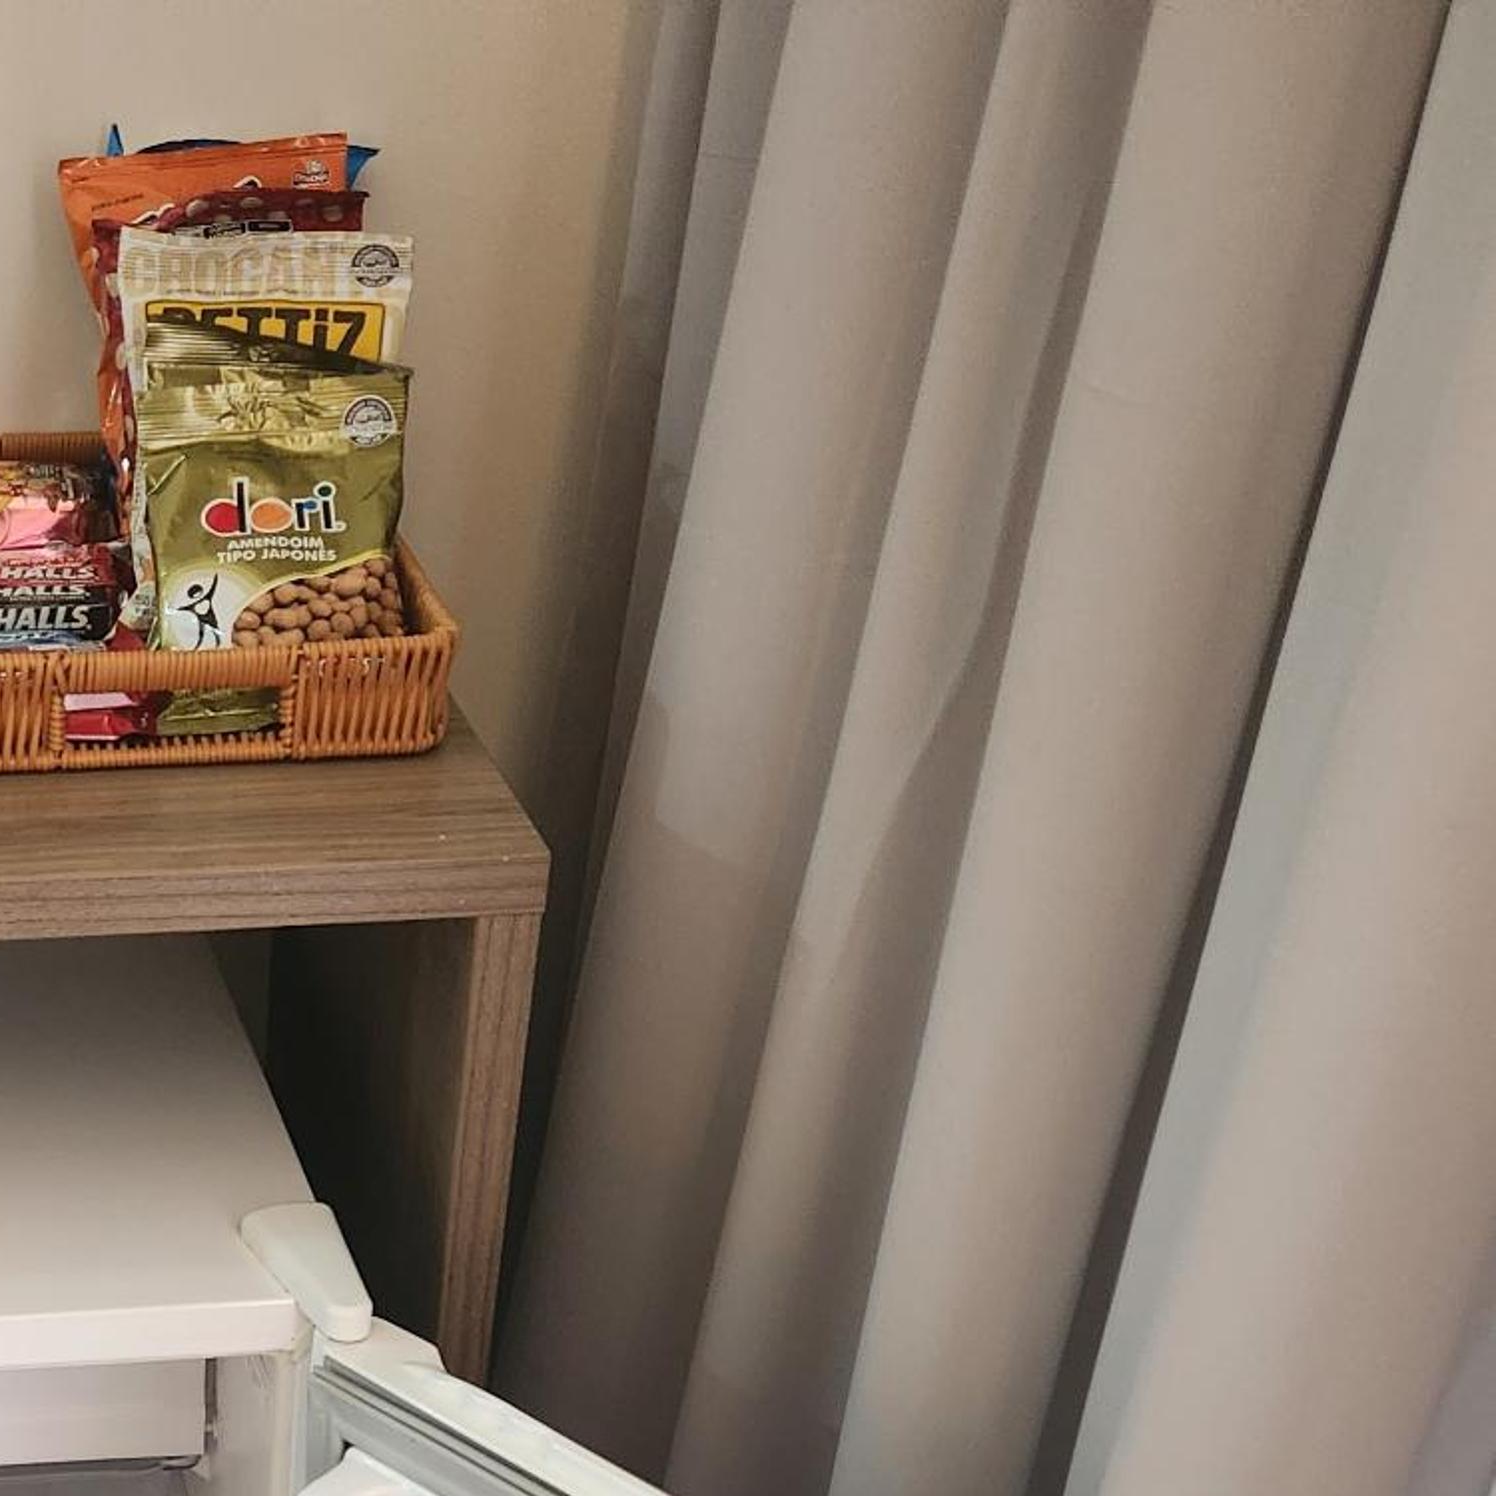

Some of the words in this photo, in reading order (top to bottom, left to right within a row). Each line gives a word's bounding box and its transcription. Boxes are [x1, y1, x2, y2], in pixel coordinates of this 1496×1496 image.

[201, 476, 340, 537] dori
[227, 536, 324, 551] AMENDOIM
[216, 549, 256, 563] TIPO
[0, 566, 95, 580] HALLS
